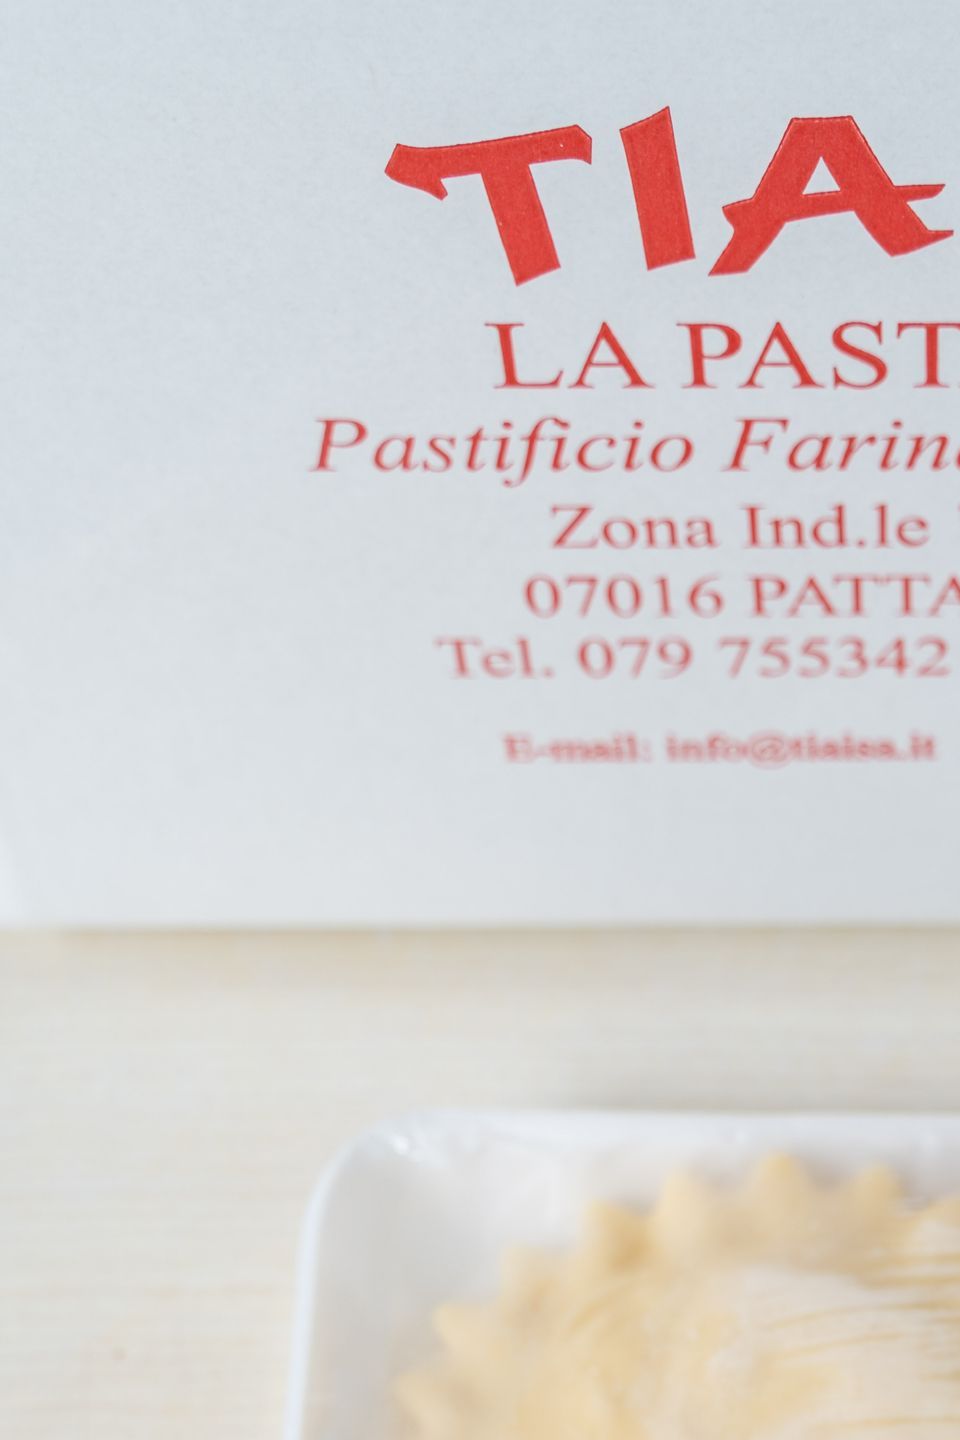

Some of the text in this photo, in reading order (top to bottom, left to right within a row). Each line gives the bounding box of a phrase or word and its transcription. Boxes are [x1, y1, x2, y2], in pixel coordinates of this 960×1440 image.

[383, 105, 954, 287] TIA
[484, 321, 653, 389] LA
[313, 416, 694, 487] Pastificio
[550, 504, 718, 549] Zona
[744, 503, 928, 548] Ind.le
[523, 575, 724, 617] 07016
[435, 635, 554, 678] Tel.
[576, 636, 694, 678] 079
[718, 635, 949, 678] 755342
[502, 732, 650, 763] E-mail:
[665, 732, 936, 766] info@tiaisa.it
